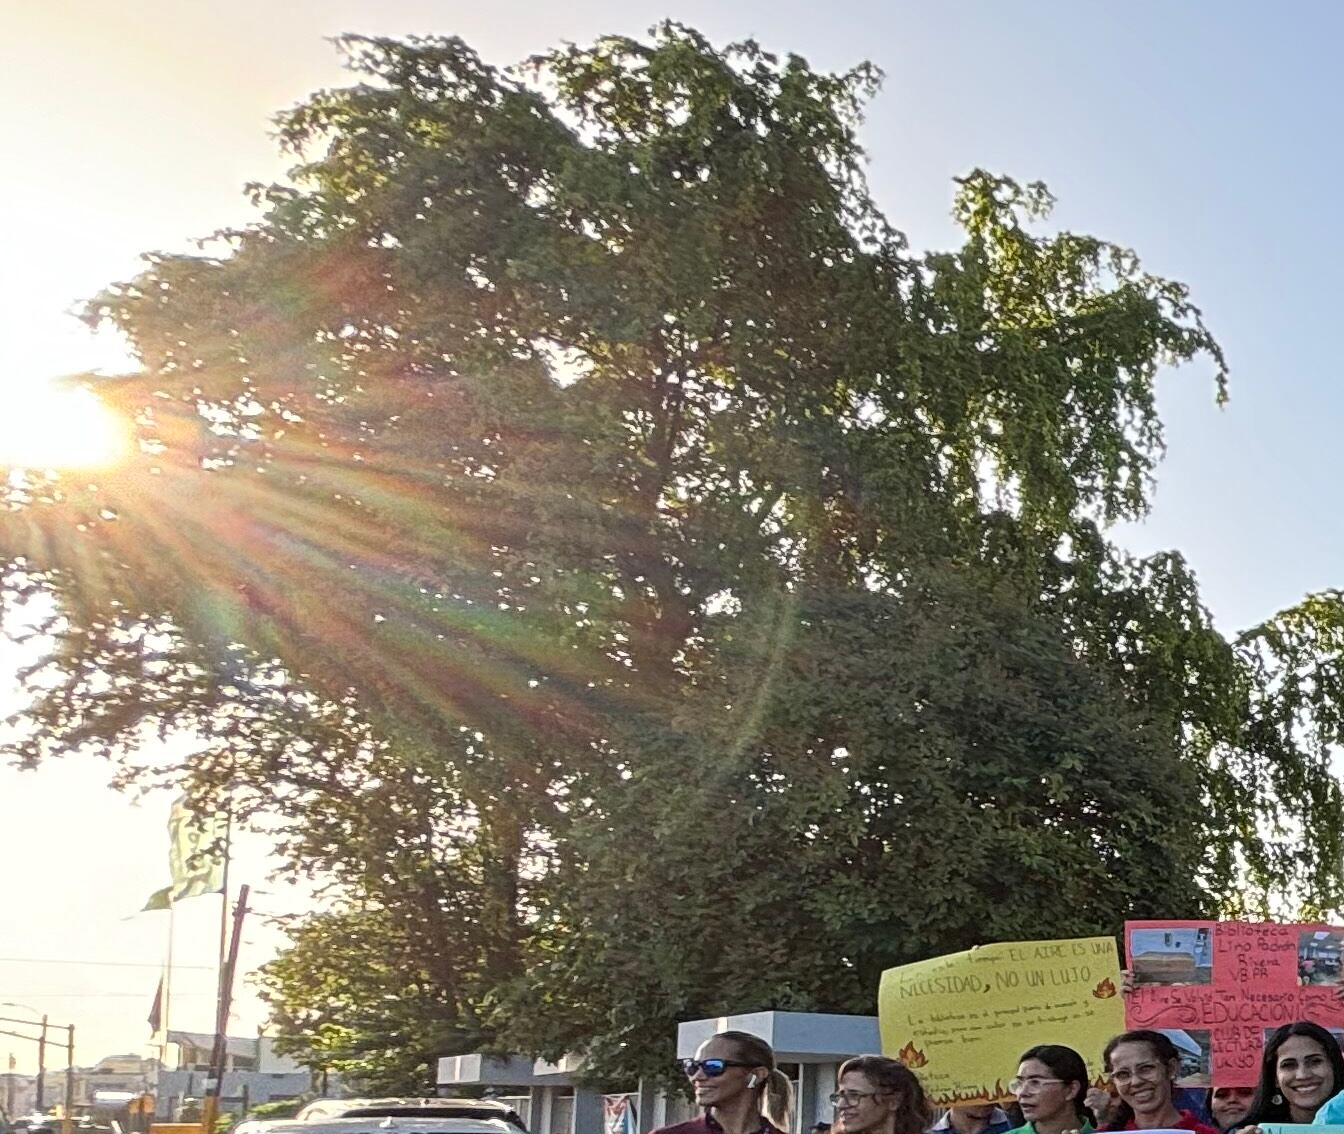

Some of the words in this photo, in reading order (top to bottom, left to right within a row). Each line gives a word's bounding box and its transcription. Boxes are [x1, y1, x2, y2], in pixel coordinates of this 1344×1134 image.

[995, 970, 1020, 992] NO
[1025, 969, 1045, 987] UN
[1049, 966, 1092, 986] LUJO
